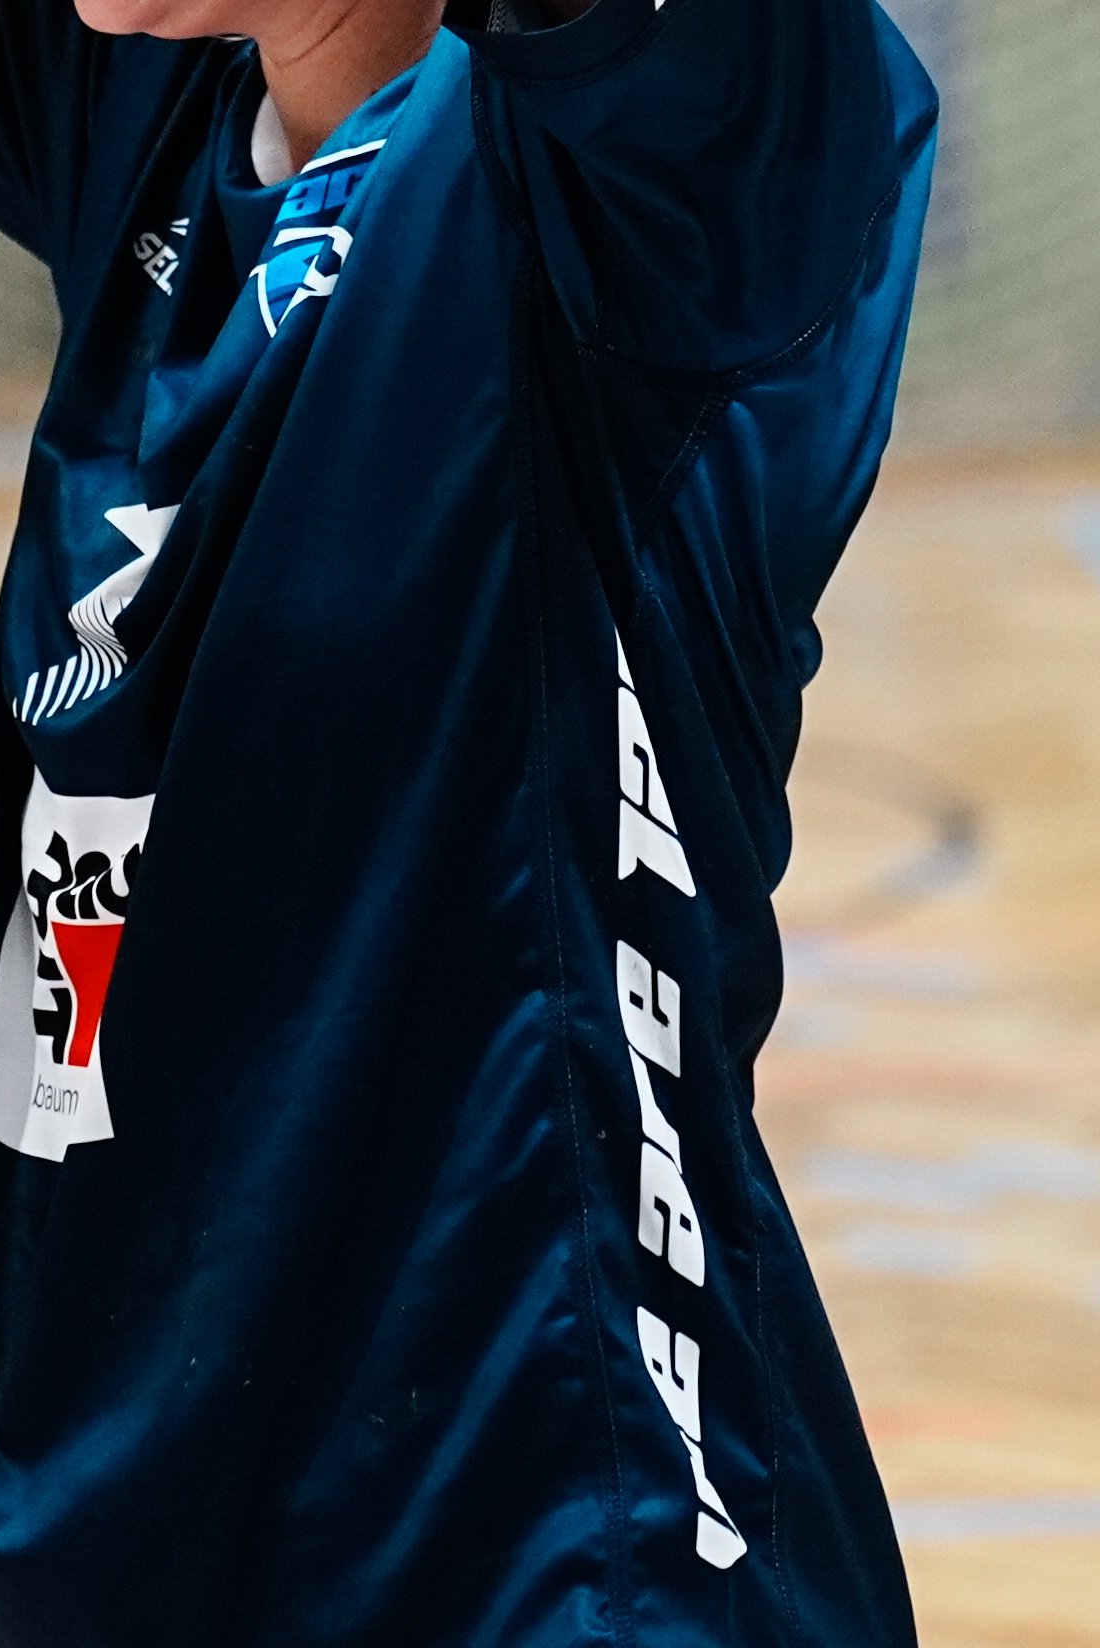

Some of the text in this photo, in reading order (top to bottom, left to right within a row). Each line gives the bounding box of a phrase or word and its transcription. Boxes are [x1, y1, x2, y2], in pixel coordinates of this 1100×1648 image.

[133, 231, 180, 297] SEL
[32, 1073, 79, 1115] baum
[616, 939, 705, 1288] are
